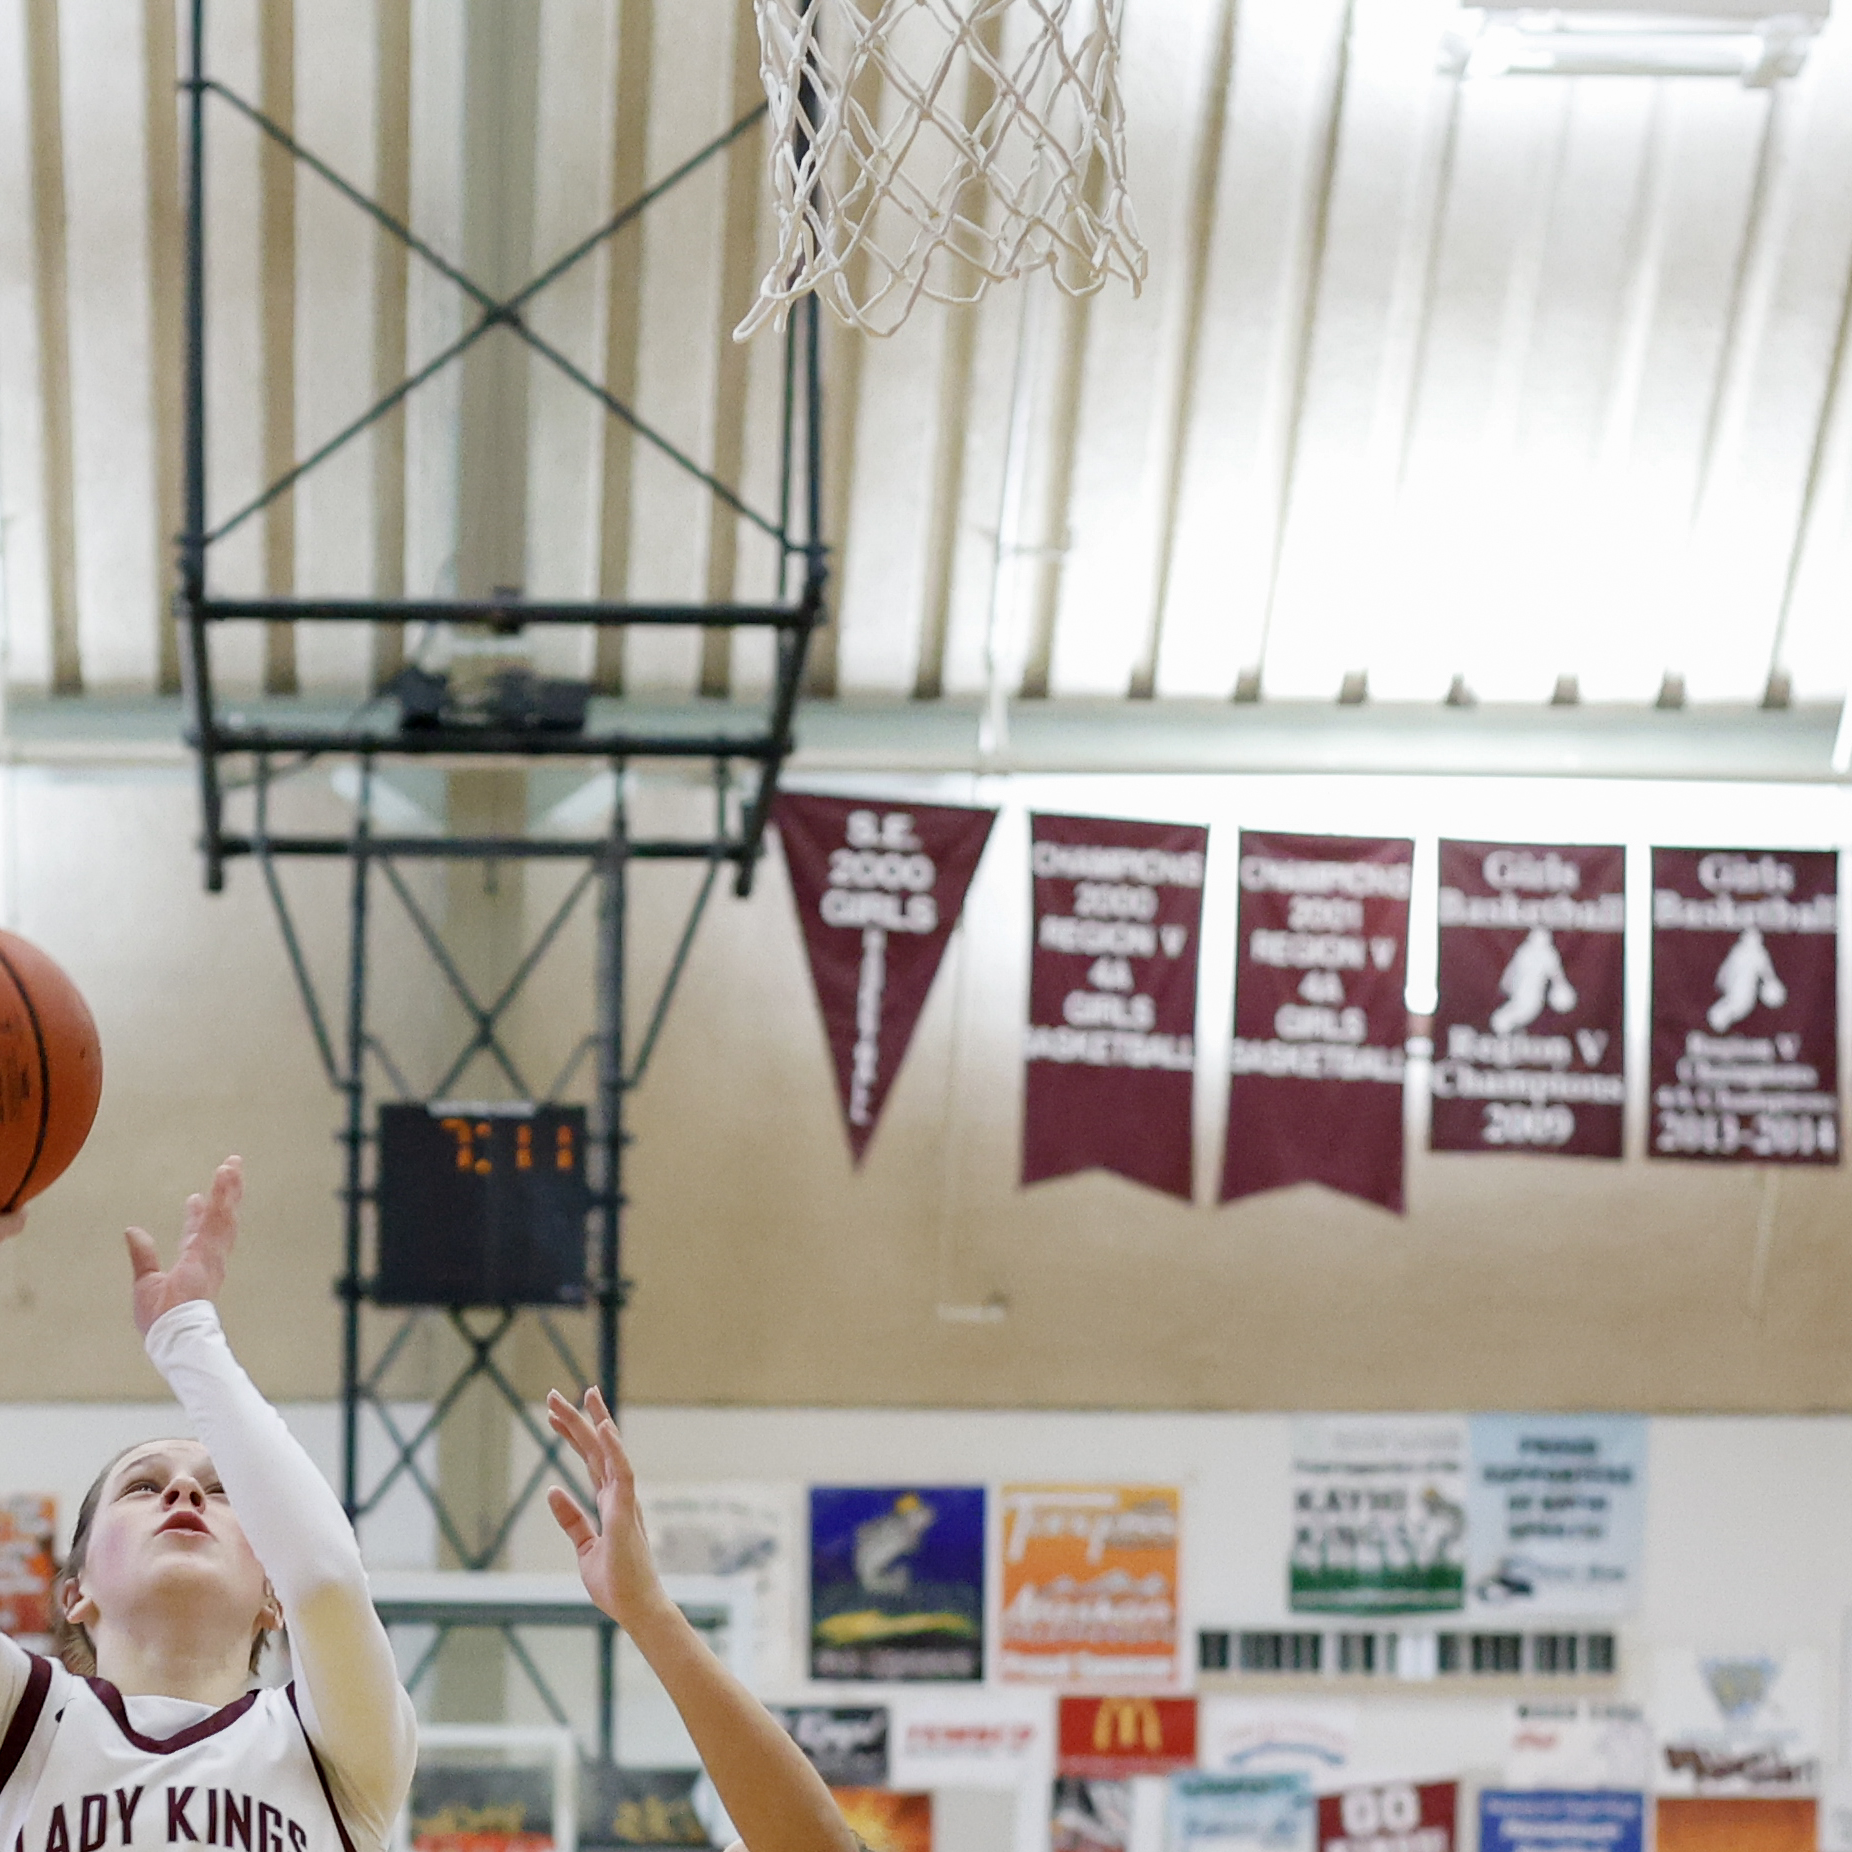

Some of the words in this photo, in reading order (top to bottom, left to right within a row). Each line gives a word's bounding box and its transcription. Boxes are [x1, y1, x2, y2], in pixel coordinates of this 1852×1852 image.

[829, 850, 937, 891] 2000
[1483, 850, 1580, 893] Girls
[1698, 854, 1795, 896] Girls
[820, 888, 939, 933] GIRLS
[1438, 886, 1626, 933] Basketball
[1653, 890, 1838, 934] Basketball
[1063, 990, 1156, 1032] GIRLS
[1274, 1002, 1368, 1045] GIRLS
[1025, 1026, 1195, 1072] BASKETBALL
[1231, 1038, 1405, 1084] BASKETBALL
[1447, 1024, 1572, 1066] Region
[1576, 1029, 1608, 1067] V
[1432, 1060, 1626, 1107] Champions
[1341, 1786, 1421, 1837] GO
